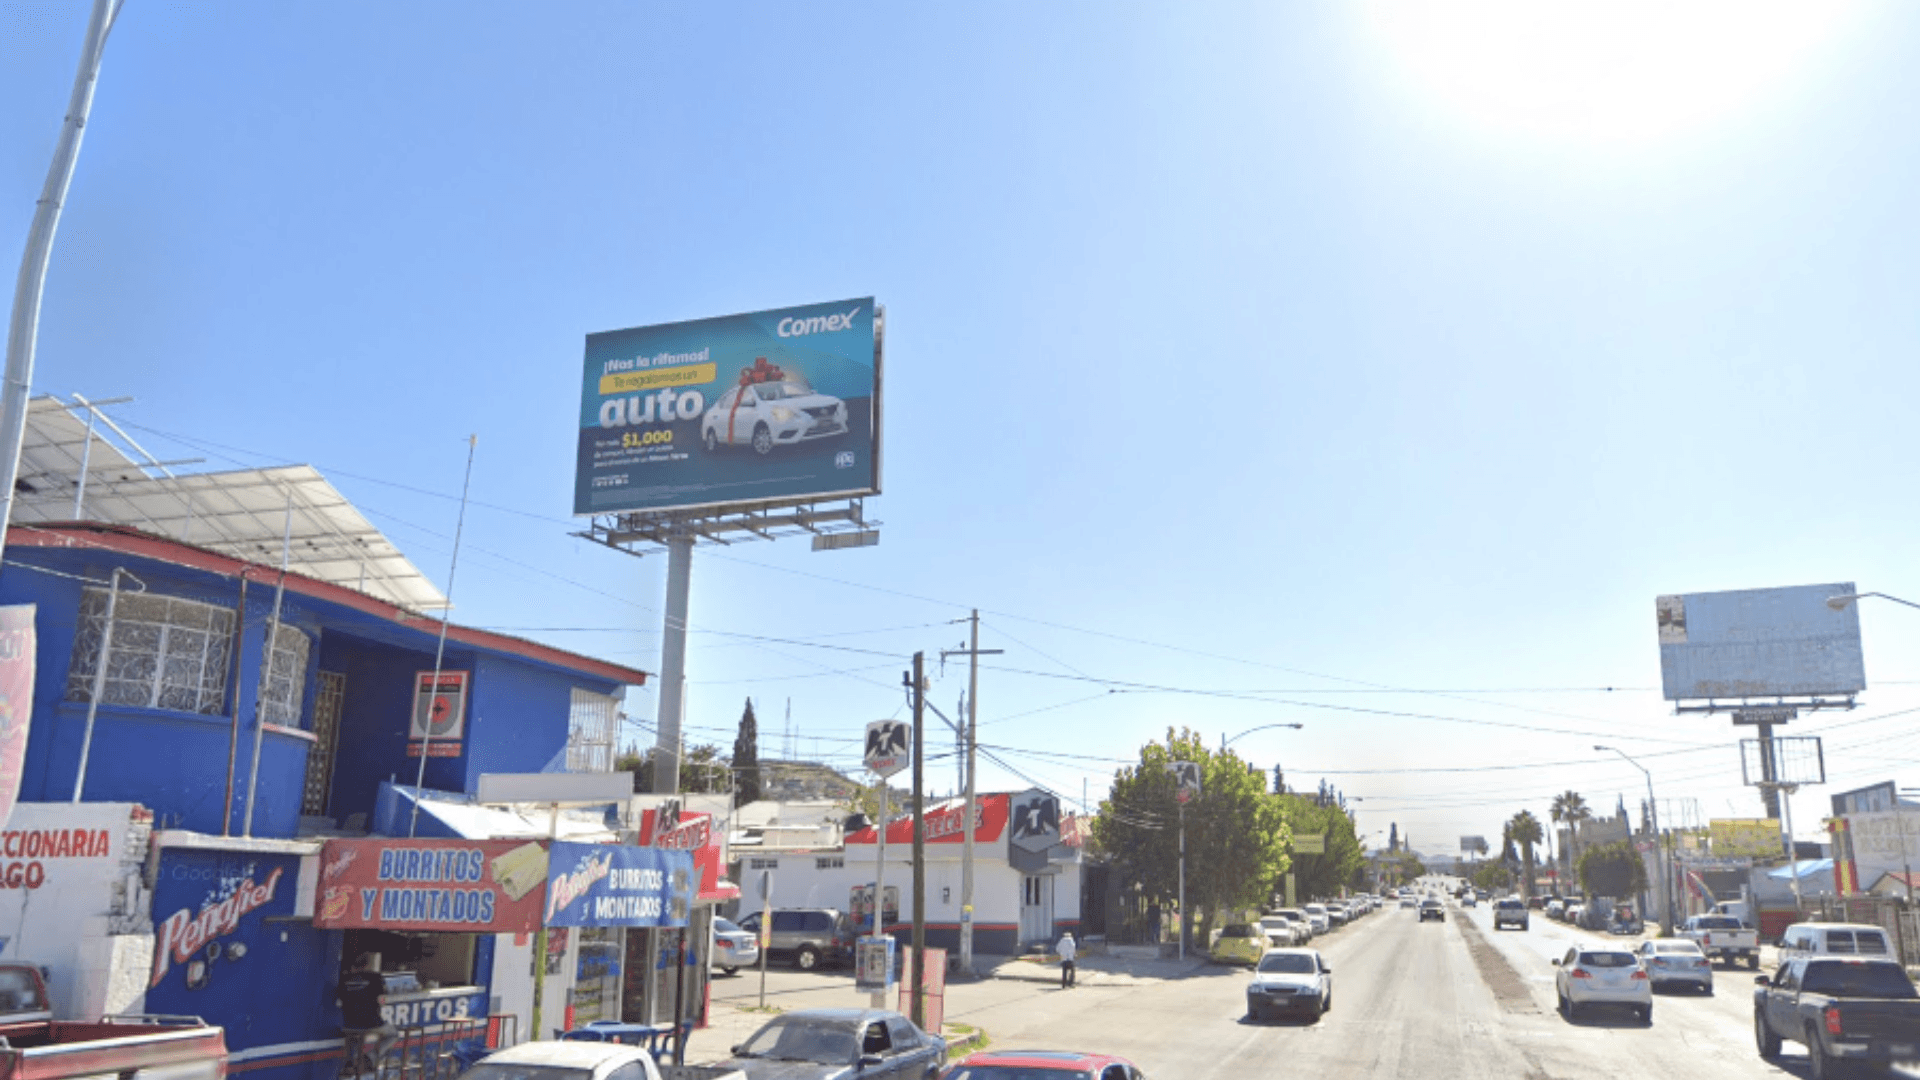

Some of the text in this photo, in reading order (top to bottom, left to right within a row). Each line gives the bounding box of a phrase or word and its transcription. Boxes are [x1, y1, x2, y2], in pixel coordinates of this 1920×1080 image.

[777, 306, 861, 337] Comex
[604, 347, 709, 375] ¡Nos la rifamos!
[599, 387, 704, 428] auto
[622, 429, 673, 448] $1,000
[924, 803, 984, 840] TECAE
[0, 861, 44, 889] GO
[378, 847, 484, 882] BURRITOS
[609, 868, 663, 891] BURRITOS
[361, 887, 496, 924] Y MONTADOS
[595, 896, 662, 920] MONTADOS
[150, 866, 283, 988] Peñafiel
[381, 997, 469, 1025] RRITOS
